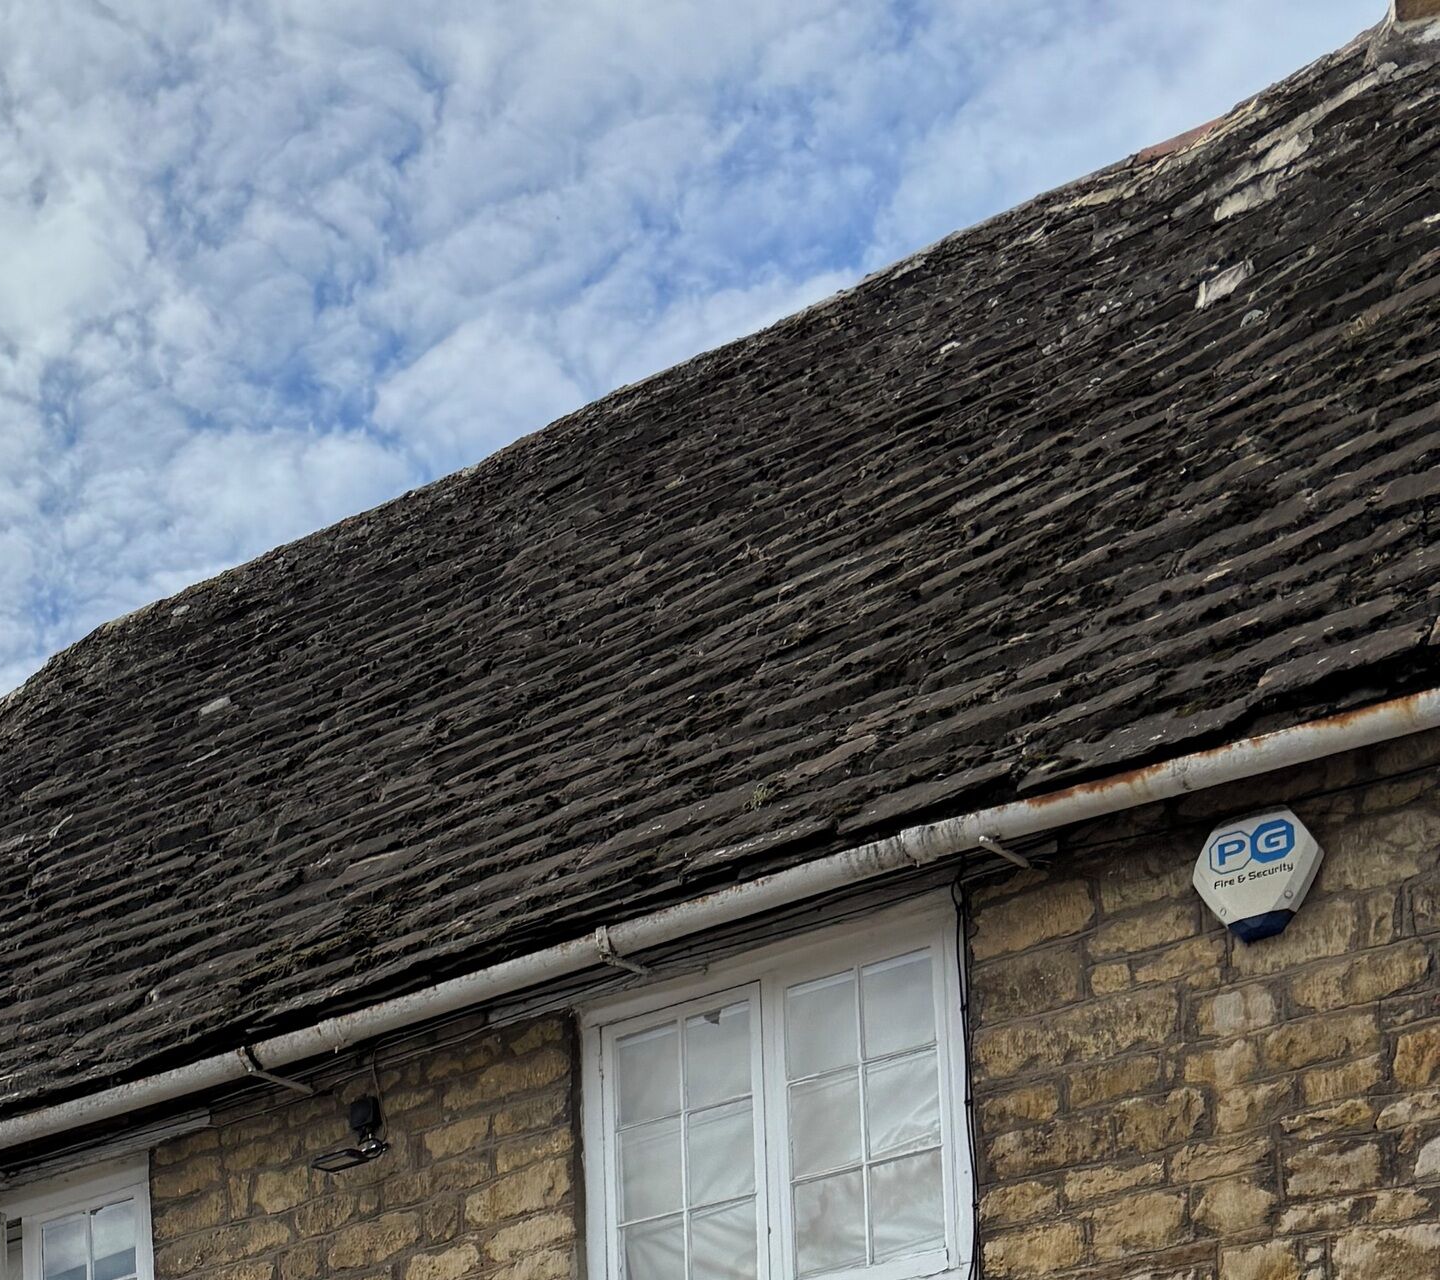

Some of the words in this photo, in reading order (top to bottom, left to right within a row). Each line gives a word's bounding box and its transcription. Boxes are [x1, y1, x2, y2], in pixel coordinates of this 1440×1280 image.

[1216, 823, 1289, 868] PG
[1213, 878, 1235, 890] Fire
[1237, 874, 1246, 884] &
[1248, 862, 1294, 881] Security
